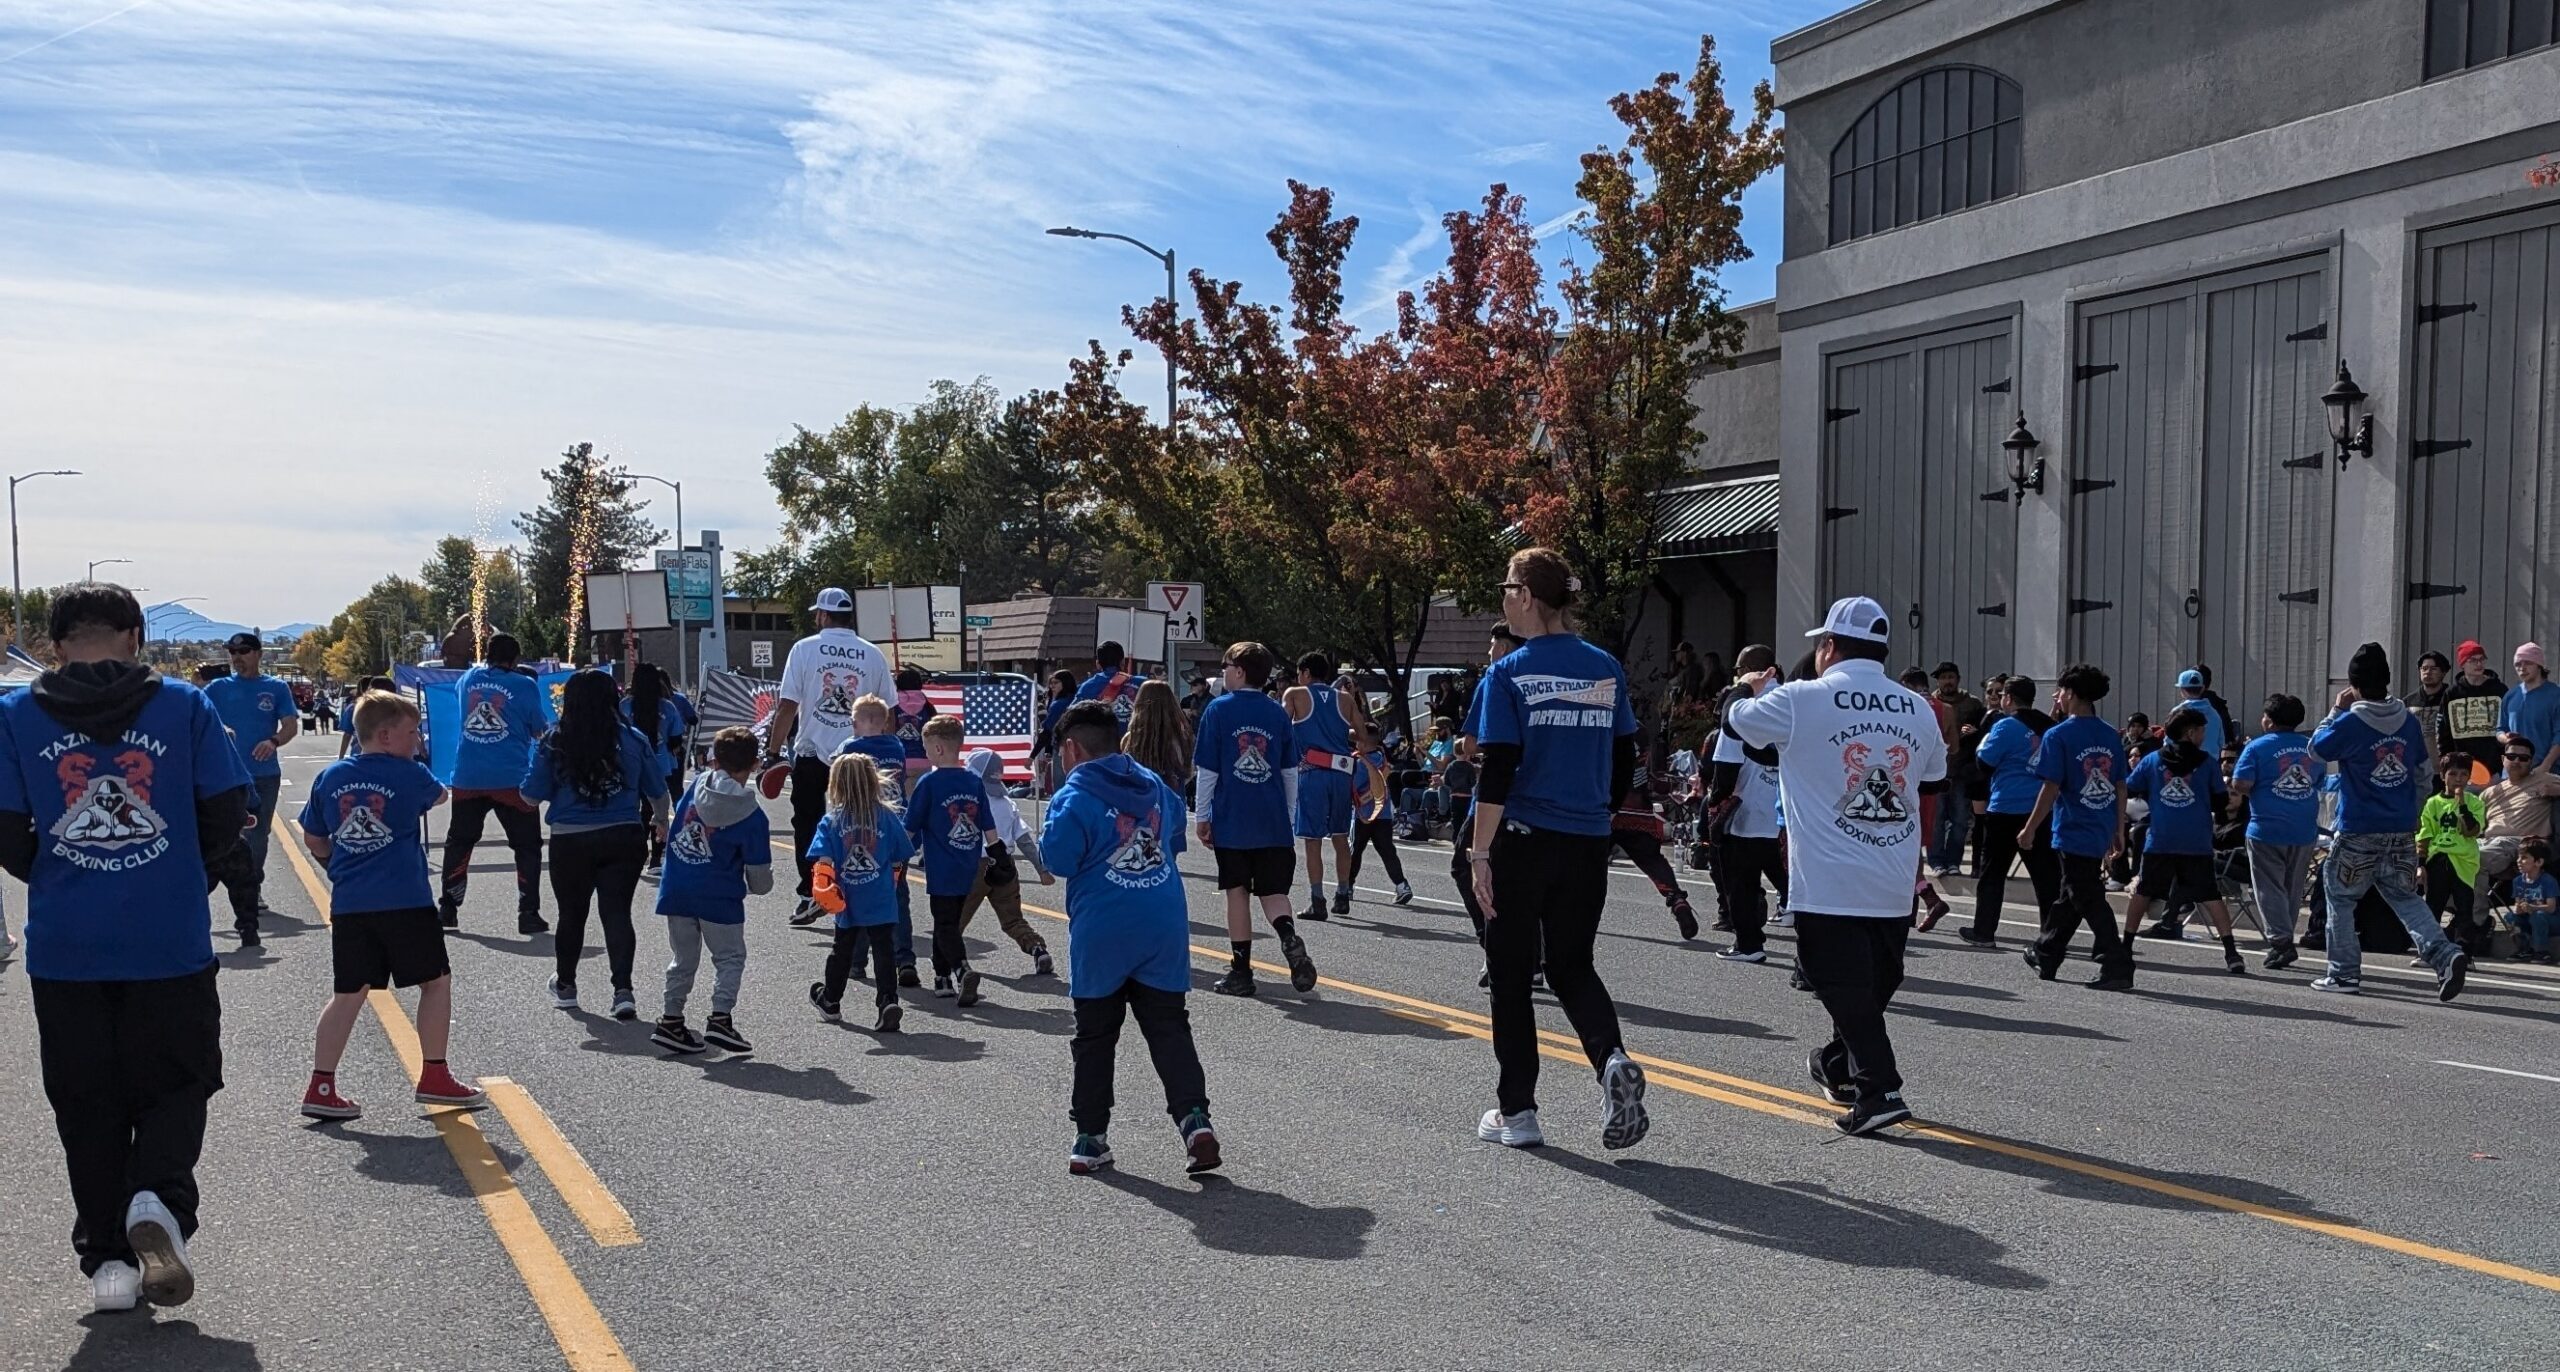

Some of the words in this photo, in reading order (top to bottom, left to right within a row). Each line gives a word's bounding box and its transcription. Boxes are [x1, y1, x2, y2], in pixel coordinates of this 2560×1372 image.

[933, 610, 955, 618] erra
[755, 654, 771, 664] 25
[820, 644, 865, 660] COACH
[816, 661, 866, 678] TAZMANIAN
[1521, 682, 1554, 697] ROCK
[1555, 681, 1597, 693] STEADY
[1834, 690, 1915, 715] COACH
[840, 719, 854, 729] CLU
[1528, 709, 1579, 727] NORTHERN
[1828, 722, 1921, 752] TAZMANIAN
[331, 782, 396, 799] TAZMANIAN
[1834, 816, 1887, 847] BOXING
[1887, 820, 1916, 847] CLUB
[367, 834, 394, 852] CLUB
[52, 842, 122, 871] BOXING
[124, 836, 169, 869] CLUB
[1105, 869, 1150, 888] BOXING
[1151, 863, 1171, 886] CLUB
